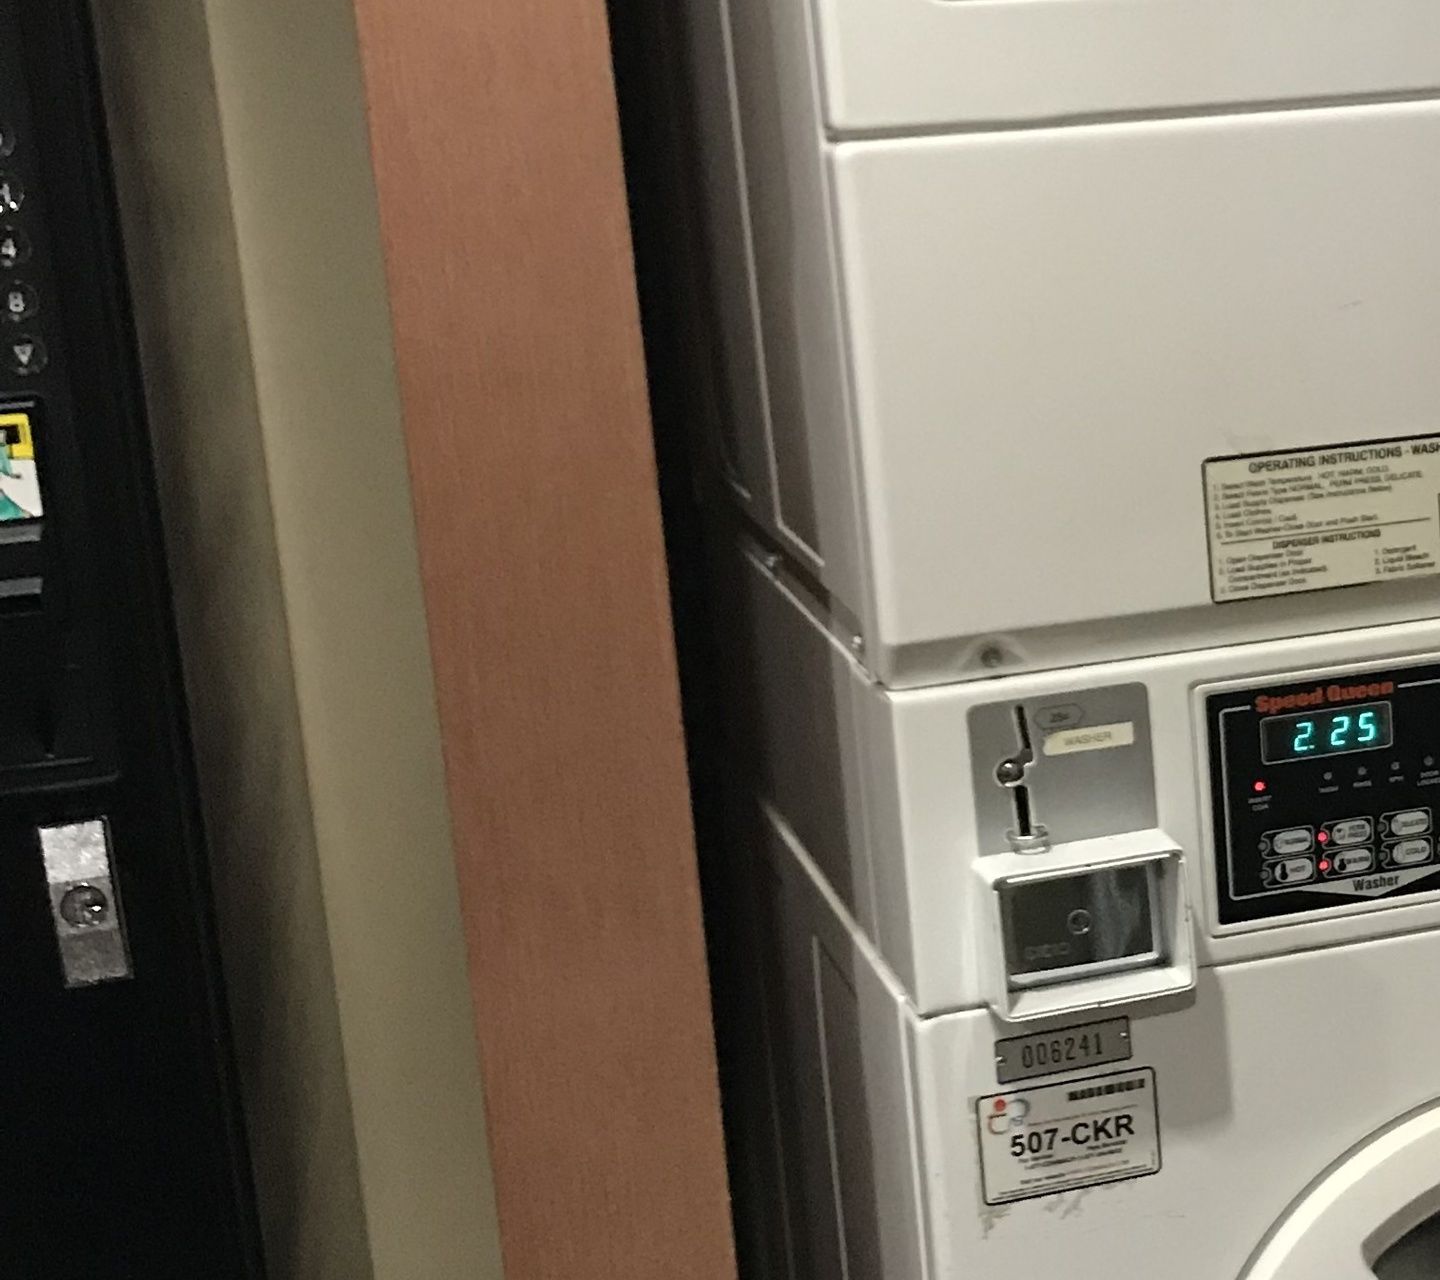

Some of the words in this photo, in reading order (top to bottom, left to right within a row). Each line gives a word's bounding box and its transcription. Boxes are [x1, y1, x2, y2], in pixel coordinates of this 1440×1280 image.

[1248, 455, 1315, 473] OPERATING
[1318, 446, 1402, 465] INSTRUCTIONS
[1255, 687, 1323, 714] Speed
[1327, 681, 1394, 701] Queen
[1353, 874, 1399, 892] Washer
[1022, 1034, 1103, 1068] 006241
[1011, 1114, 1135, 1157] 507-CKR
